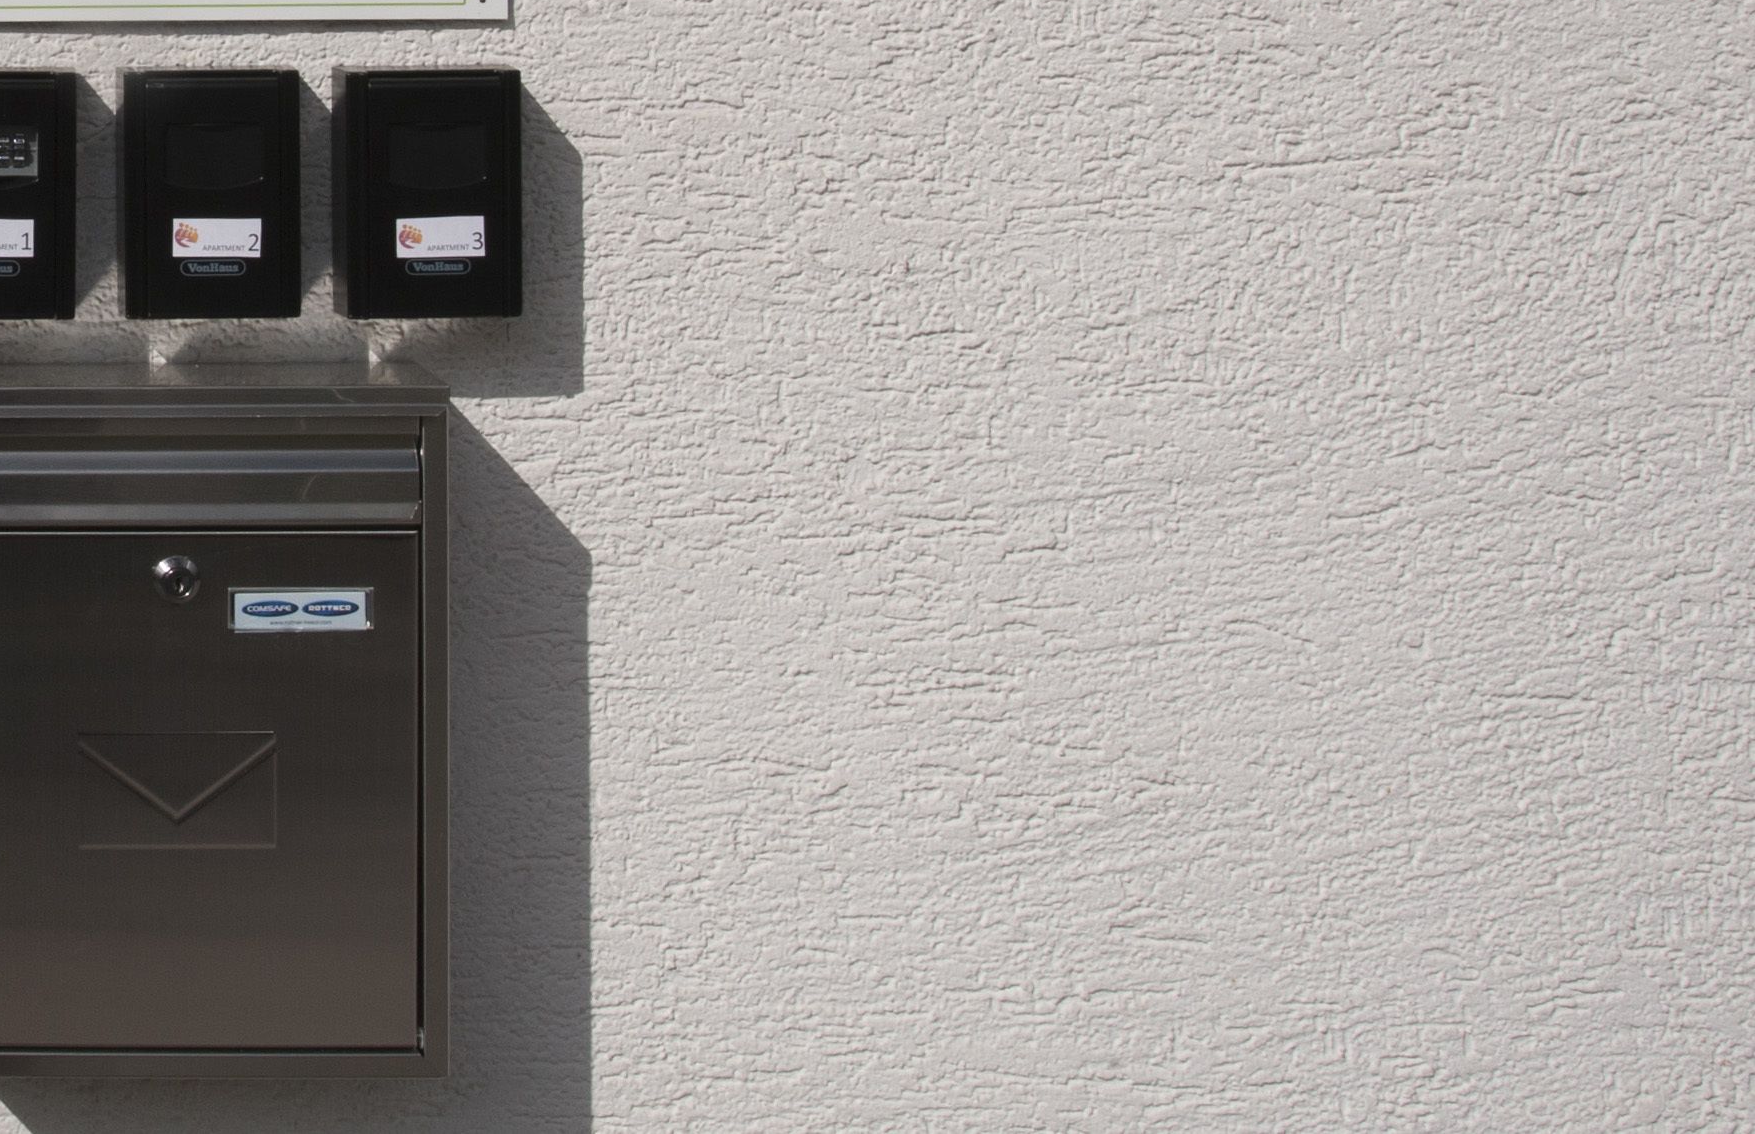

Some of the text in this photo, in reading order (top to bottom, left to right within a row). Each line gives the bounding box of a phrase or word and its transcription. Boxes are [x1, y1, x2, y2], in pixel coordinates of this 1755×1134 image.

[21, 232, 32, 251] 1
[202, 233, 260, 252] APARTMENT 2
[426, 231, 484, 252] APARTMENT 3
[187, 263, 241, 275] VonHaus
[411, 260, 464, 274] VonHaus
